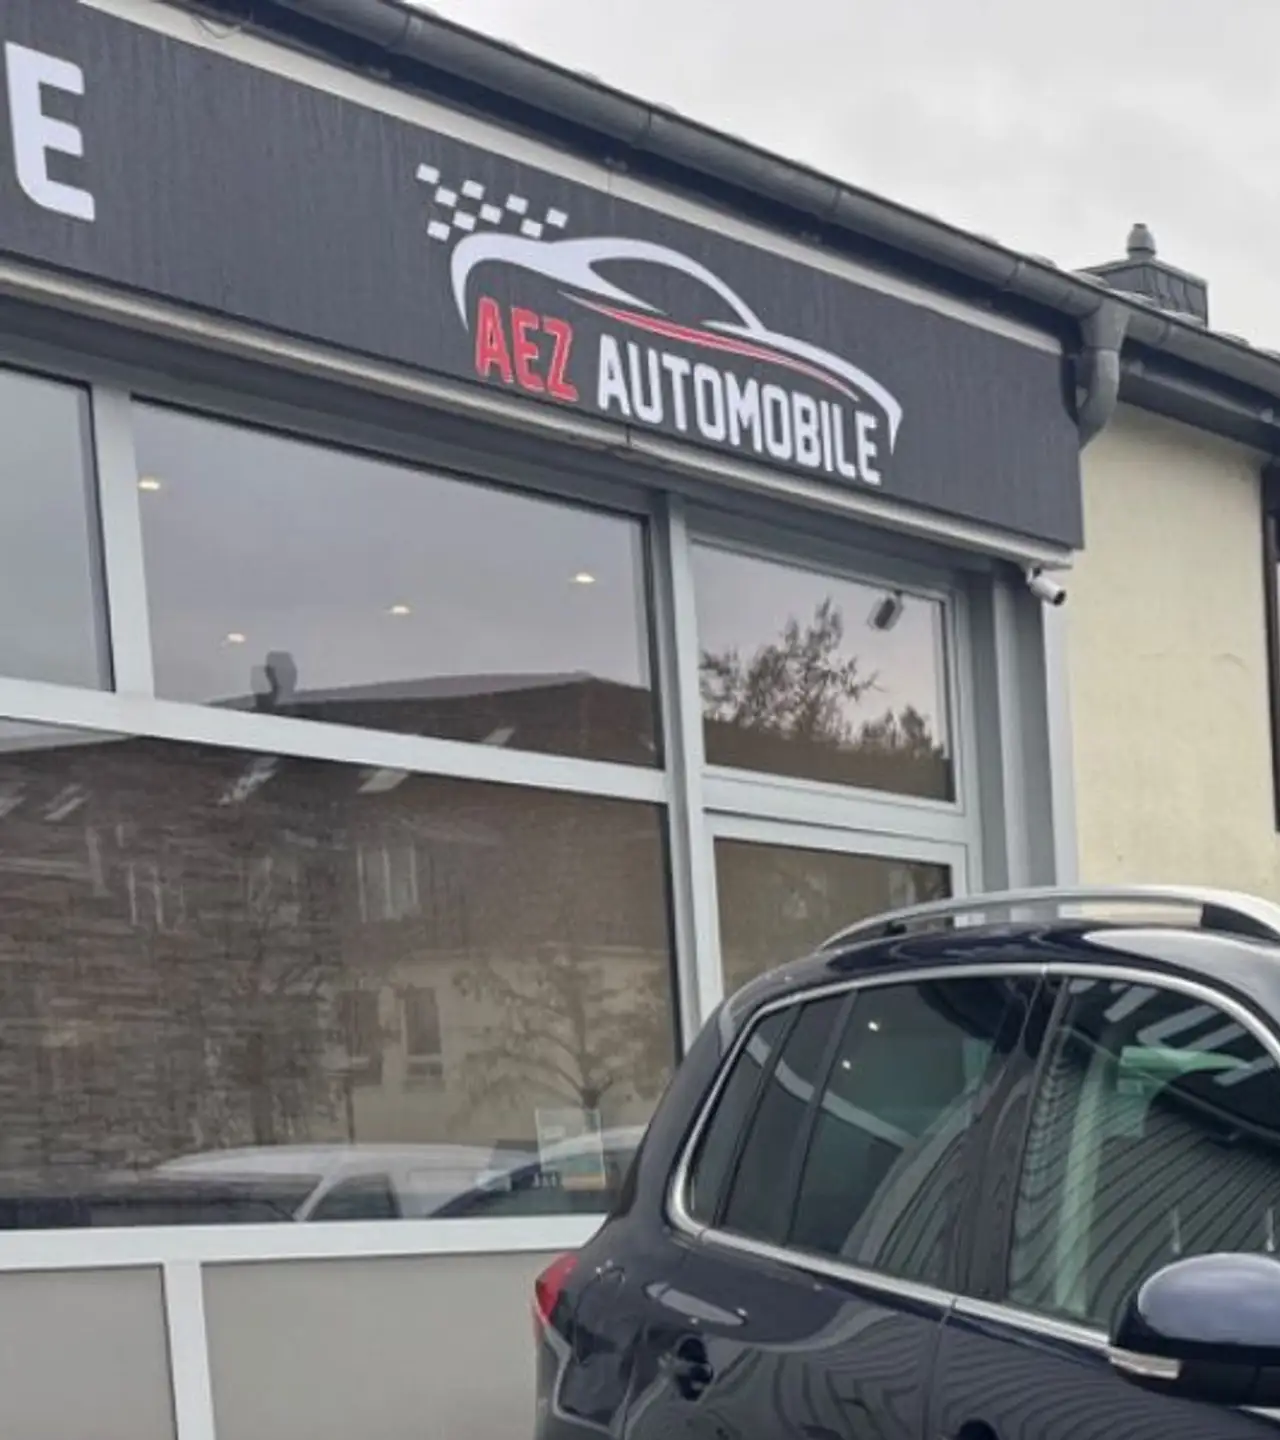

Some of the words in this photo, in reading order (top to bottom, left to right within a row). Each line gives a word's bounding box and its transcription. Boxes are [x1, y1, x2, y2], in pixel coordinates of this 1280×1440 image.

[5, 40, 95, 222] E
[474, 296, 579, 402] AEZ
[597, 333, 882, 486] AUTOMOBILE
